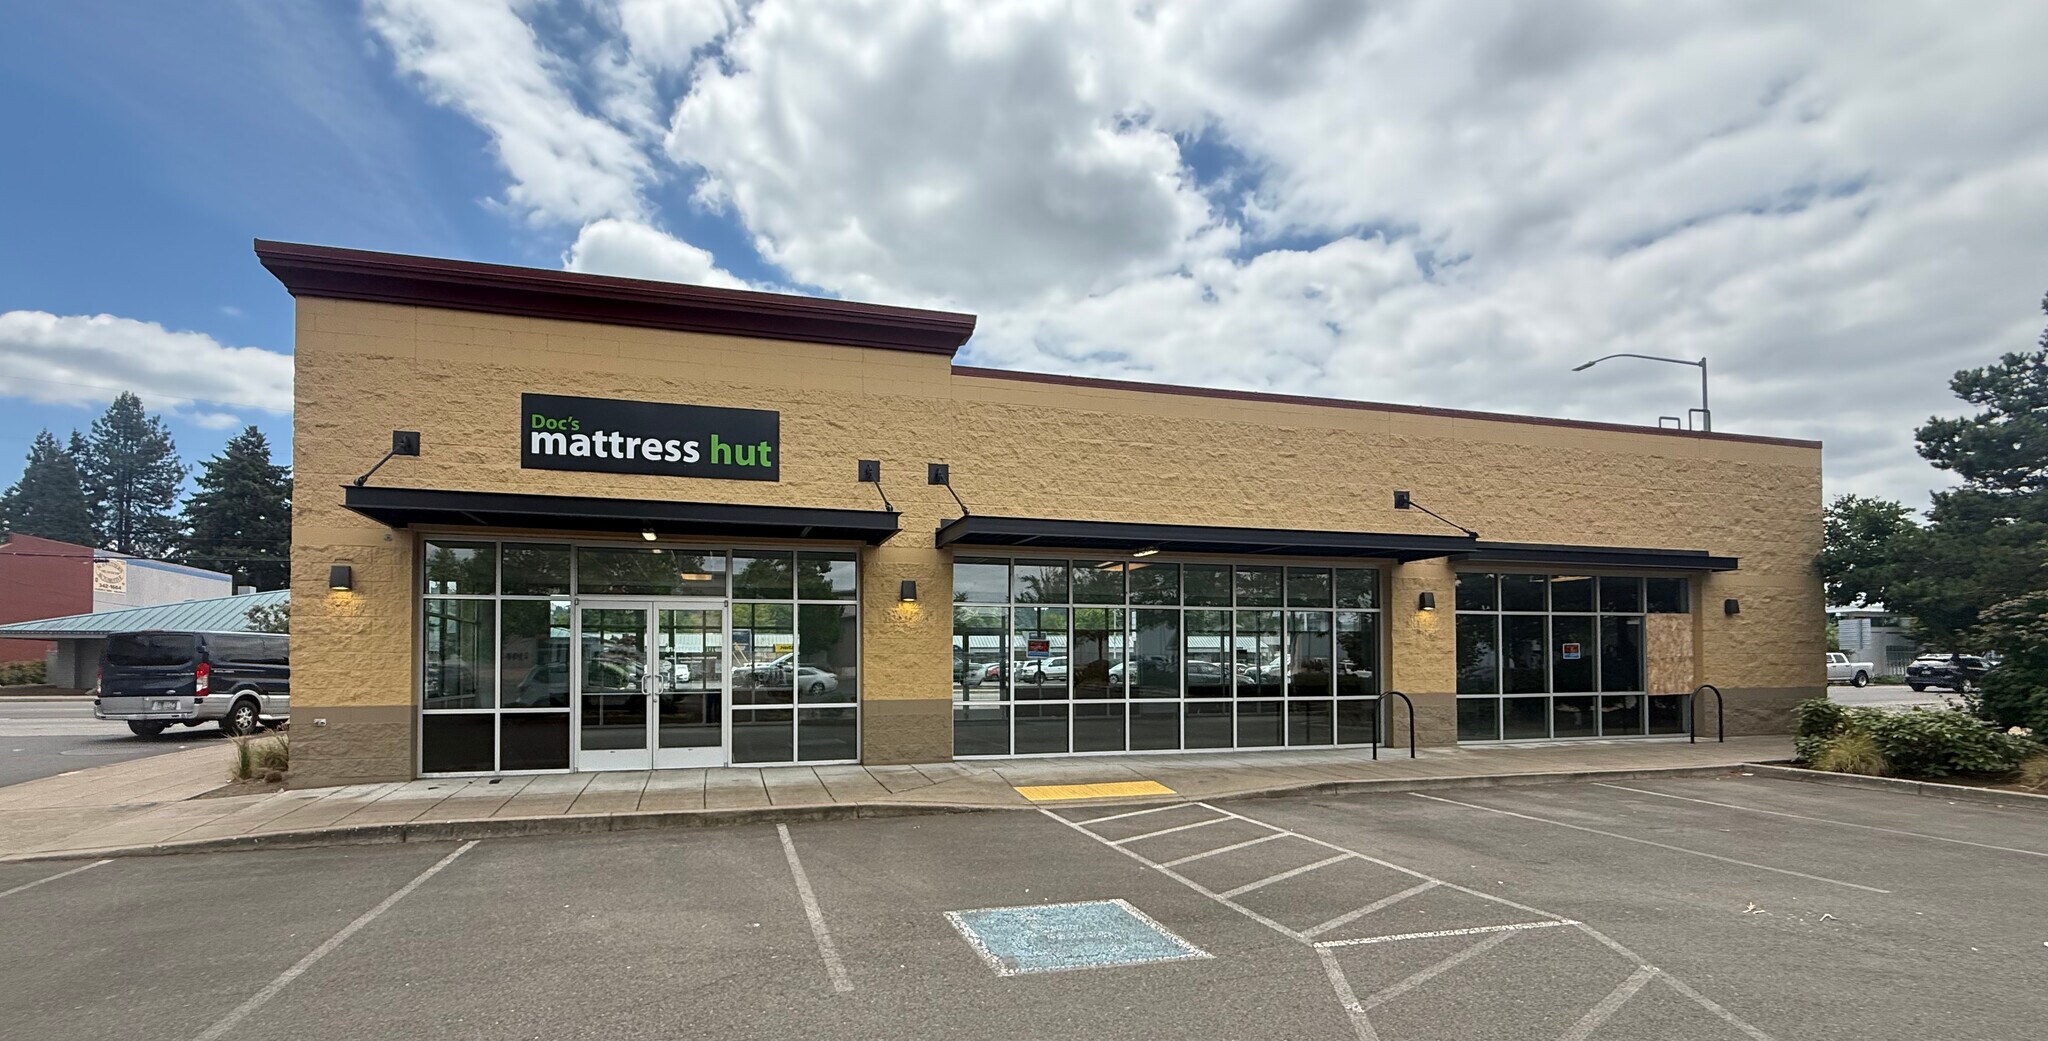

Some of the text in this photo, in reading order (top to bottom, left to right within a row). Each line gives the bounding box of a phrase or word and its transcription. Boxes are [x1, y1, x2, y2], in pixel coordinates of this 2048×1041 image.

[531, 414, 580, 431] Doc's
[531, 430, 772, 467] mattress hut
